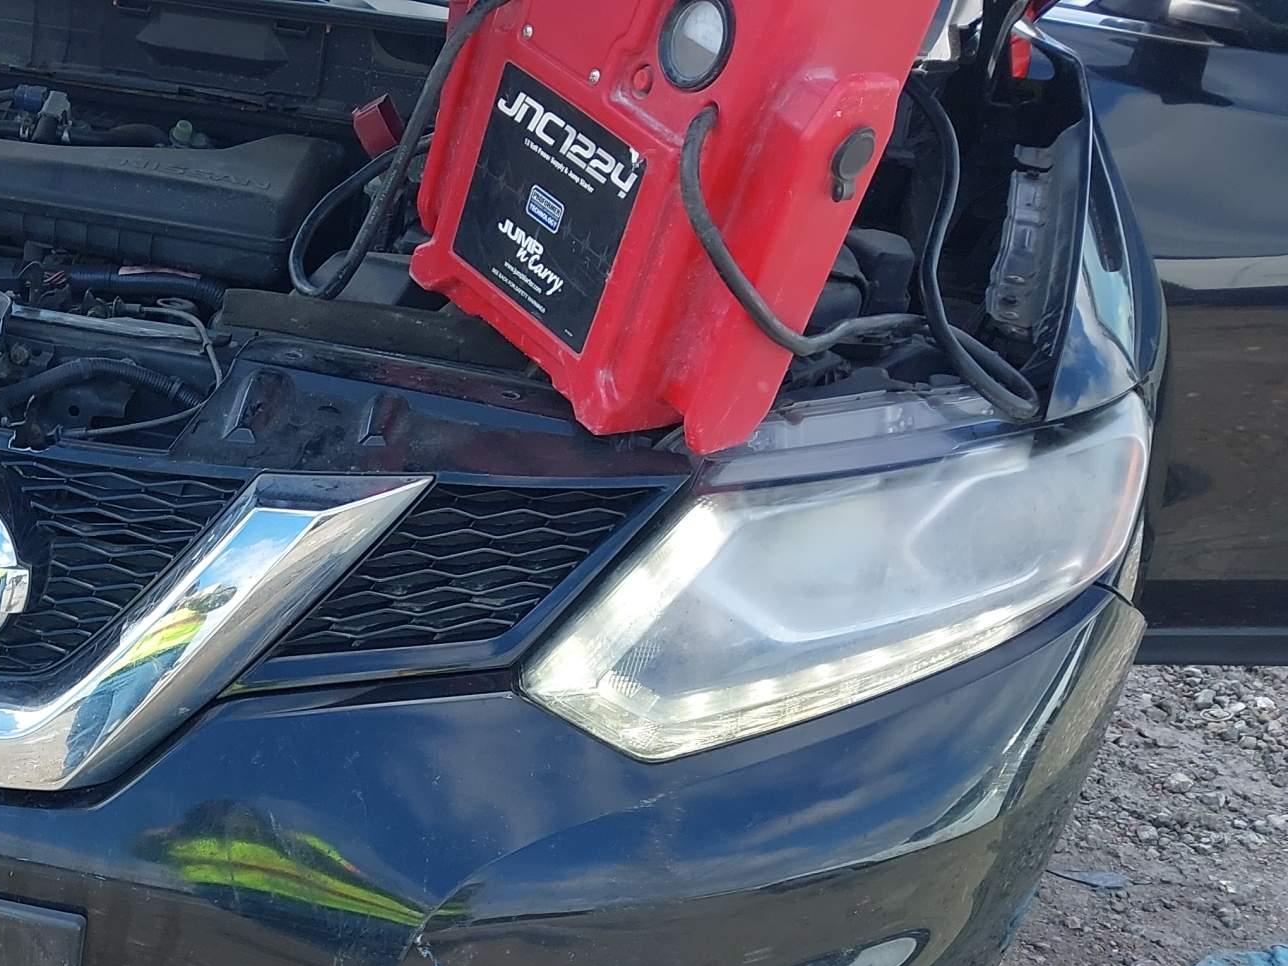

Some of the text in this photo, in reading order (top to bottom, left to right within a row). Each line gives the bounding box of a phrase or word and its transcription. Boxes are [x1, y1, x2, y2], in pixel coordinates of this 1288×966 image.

[119, 159, 272, 191] NISSAN
[529, 202, 558, 228] TECHNOLOGY
[498, 218, 544, 255] JUMP
[527, 254, 564, 296] Carry
